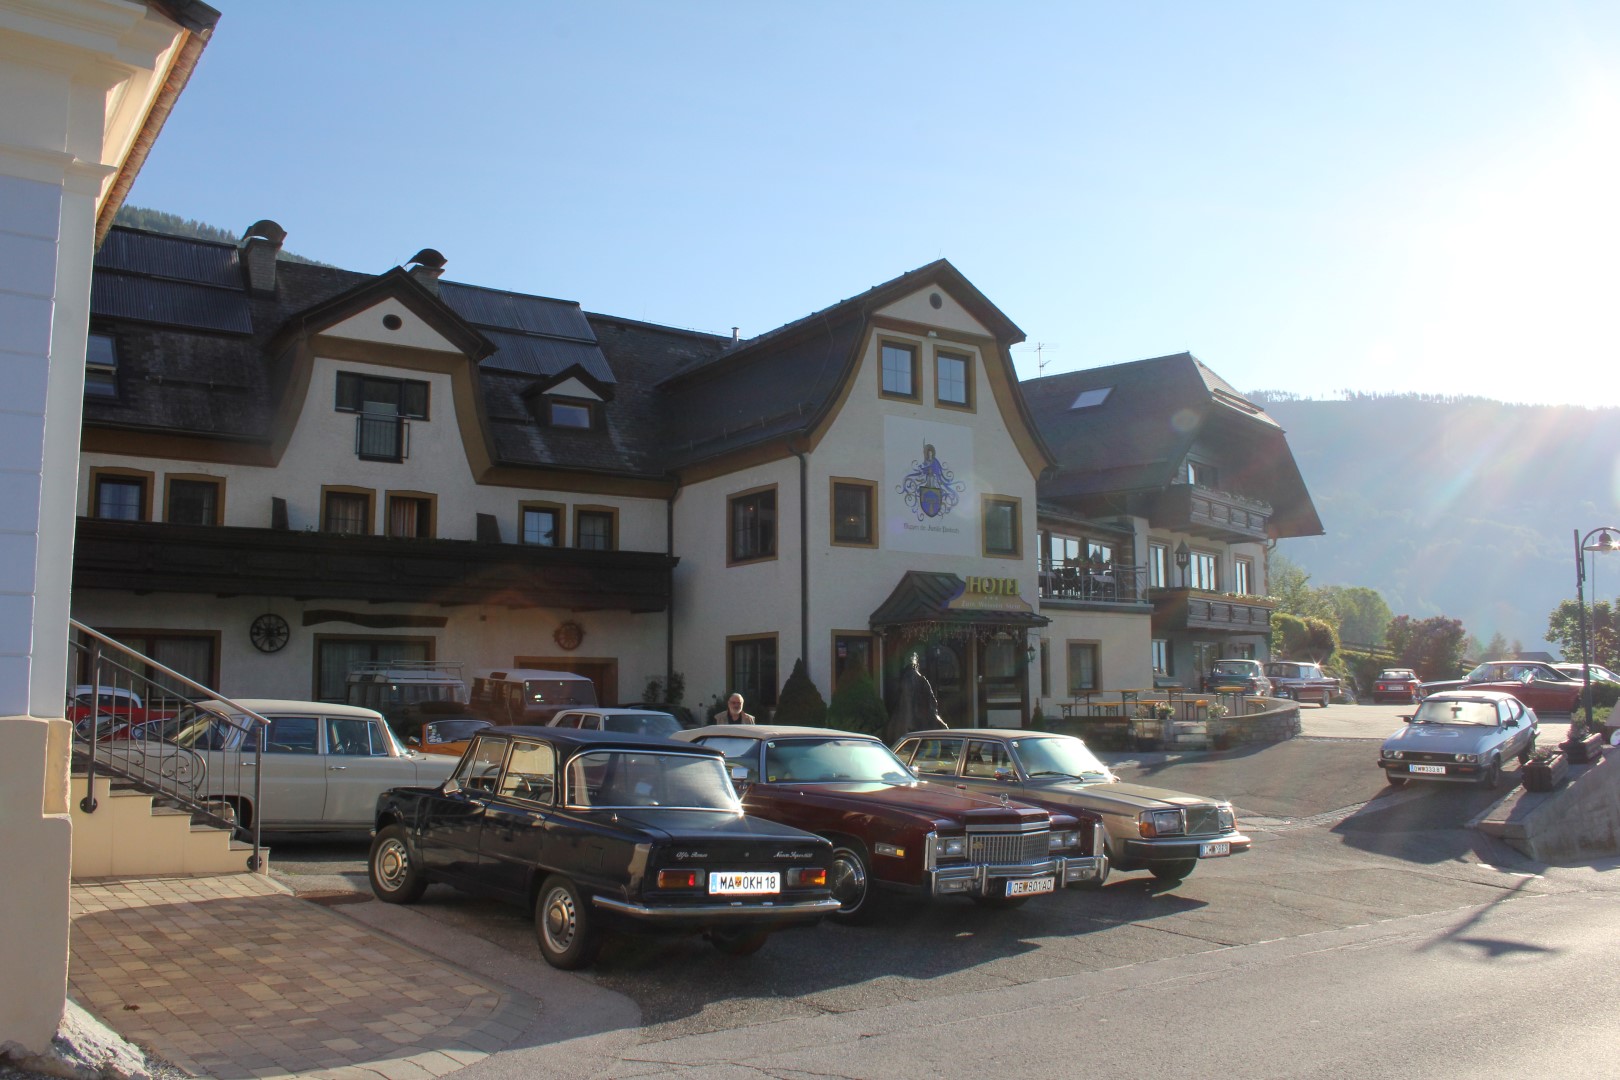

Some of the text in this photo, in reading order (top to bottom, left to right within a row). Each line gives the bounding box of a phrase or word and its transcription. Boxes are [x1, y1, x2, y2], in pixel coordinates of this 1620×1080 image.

[966, 576, 1021, 595] HOTEL
[720, 876, 735, 890] MA
[766, 876, 776, 890] 18
